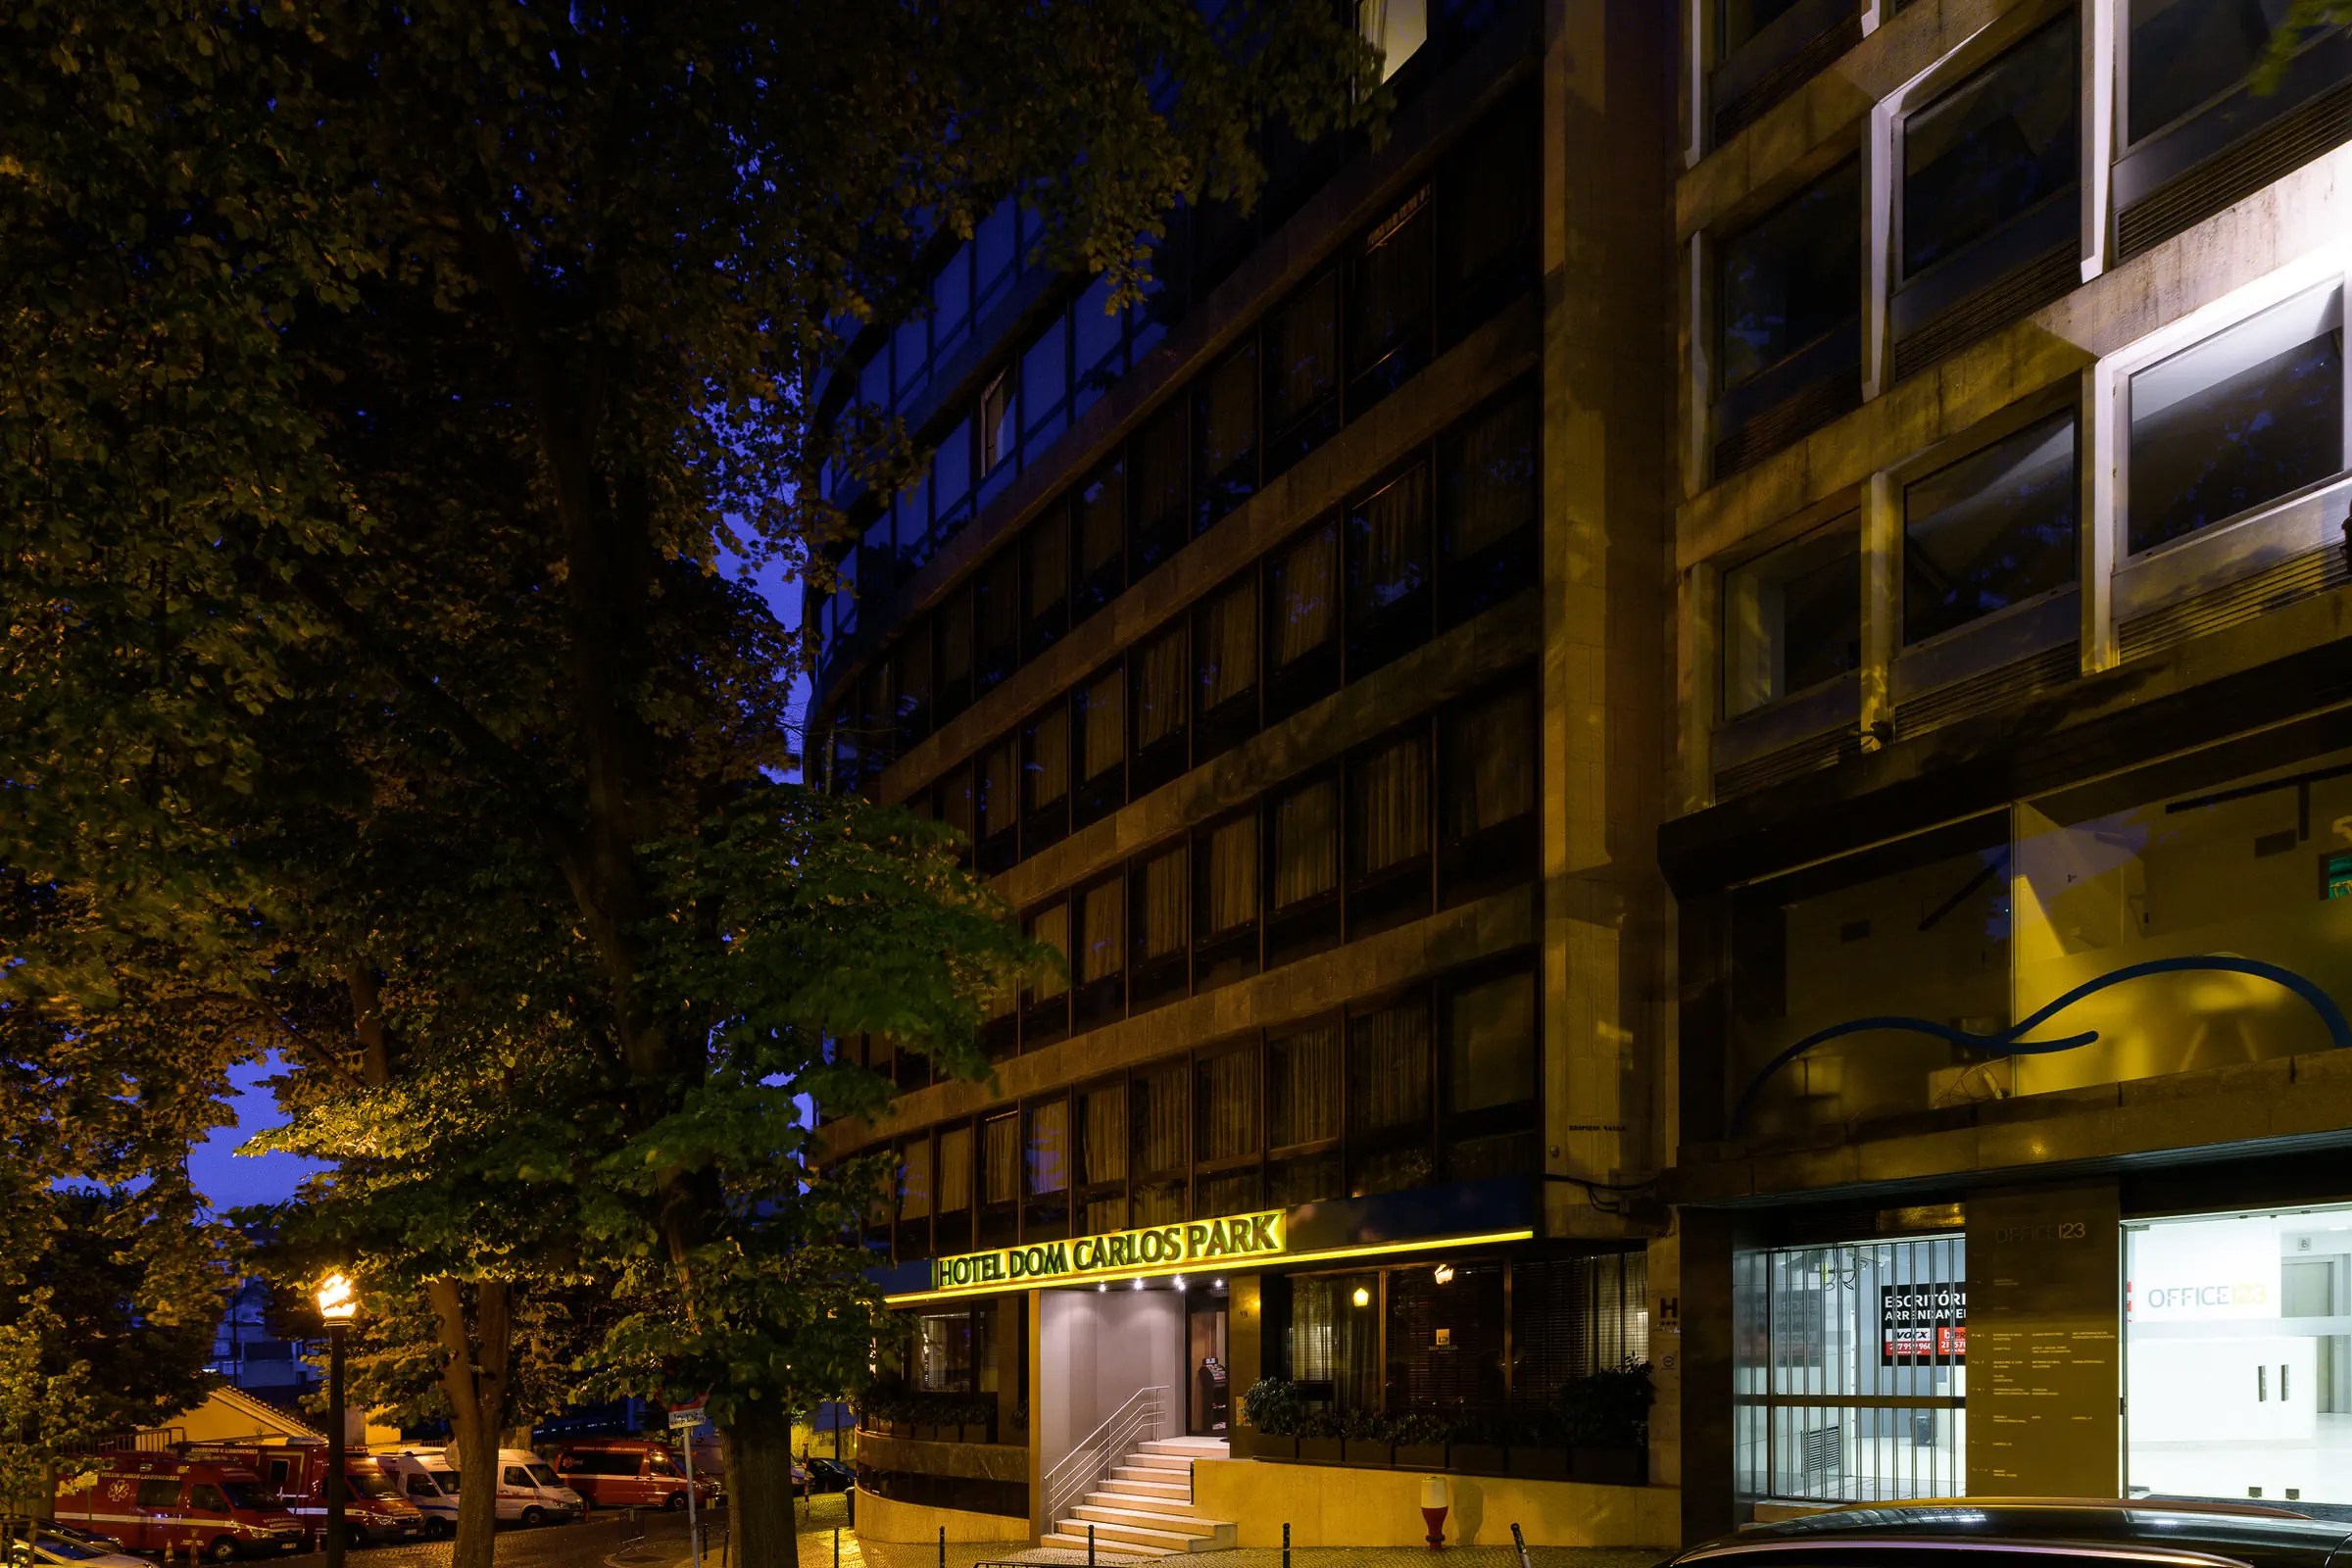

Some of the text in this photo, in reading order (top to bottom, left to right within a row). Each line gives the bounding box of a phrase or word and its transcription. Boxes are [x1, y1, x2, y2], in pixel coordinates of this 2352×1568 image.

[939, 1213, 1278, 1286] HOTEL DOM CARLOS PARK
